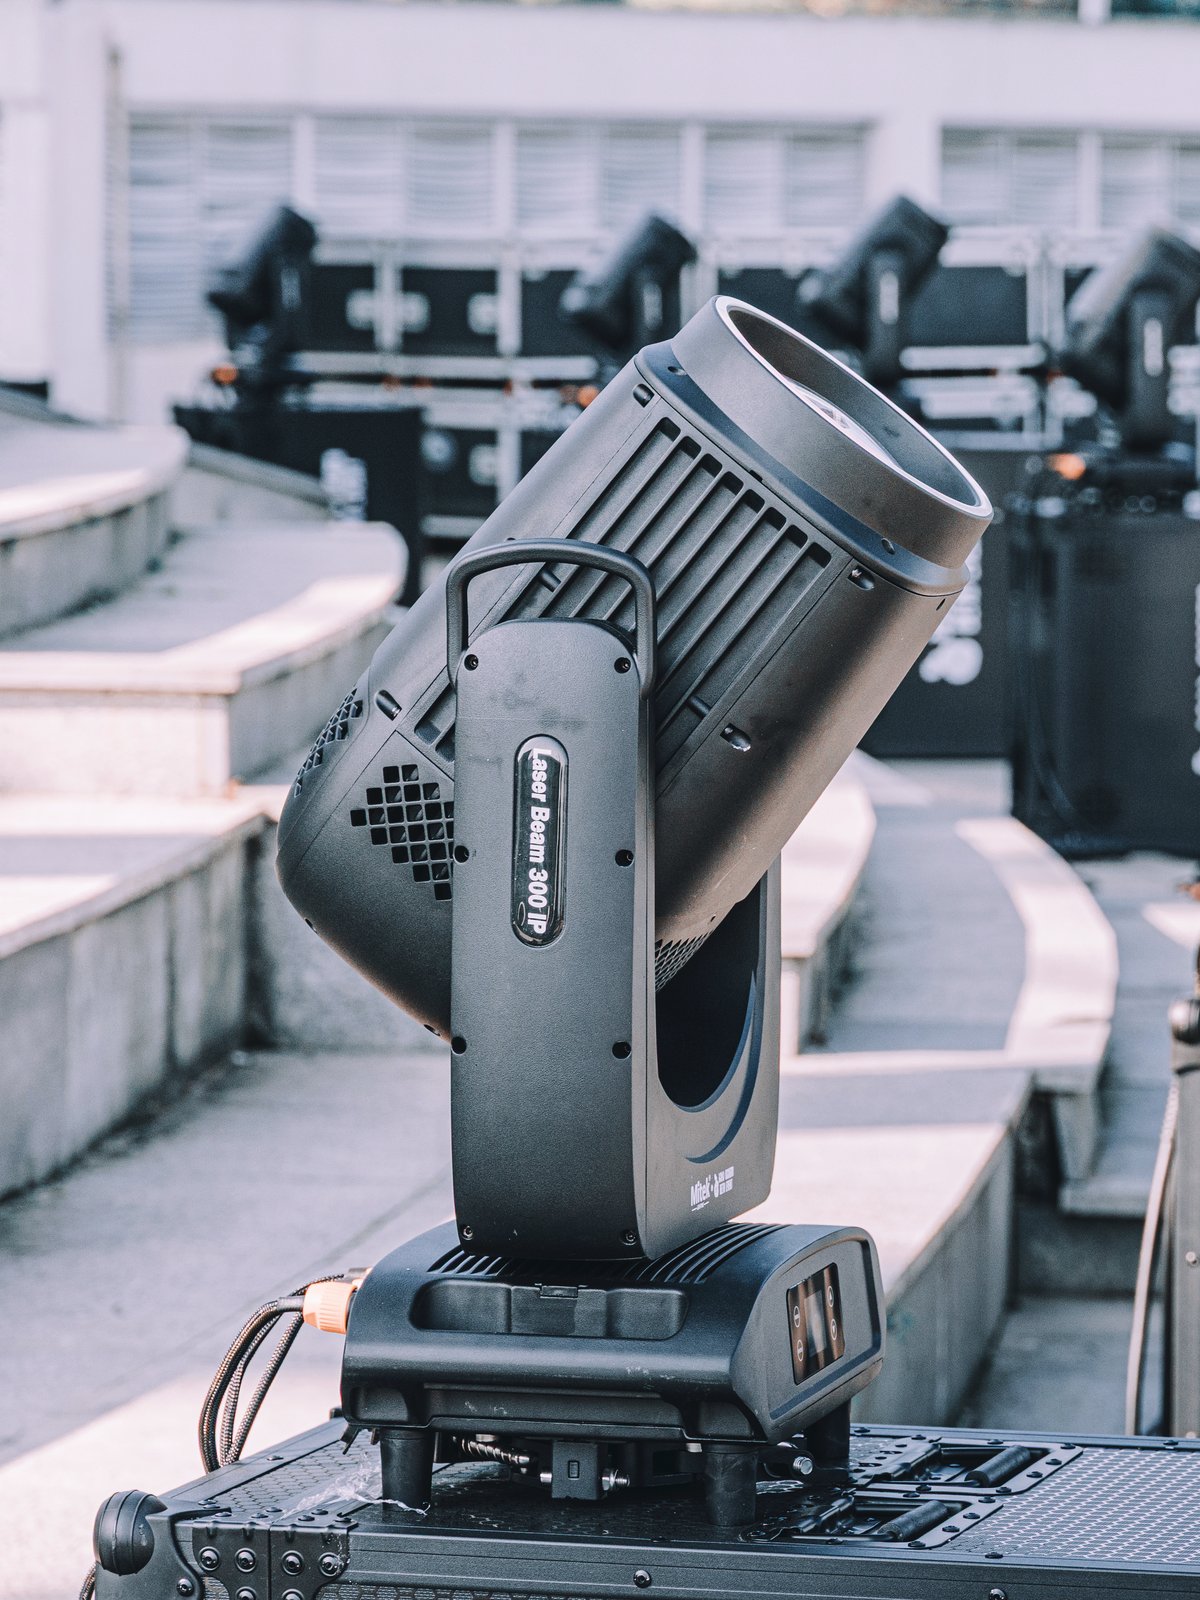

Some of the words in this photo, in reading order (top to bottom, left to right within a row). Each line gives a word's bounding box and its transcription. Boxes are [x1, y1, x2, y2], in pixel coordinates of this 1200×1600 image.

[531, 748, 551, 803] Laser
[529, 806, 550, 864] Beam
[528, 867, 549, 908] 300
[527, 912, 547, 935] IP
